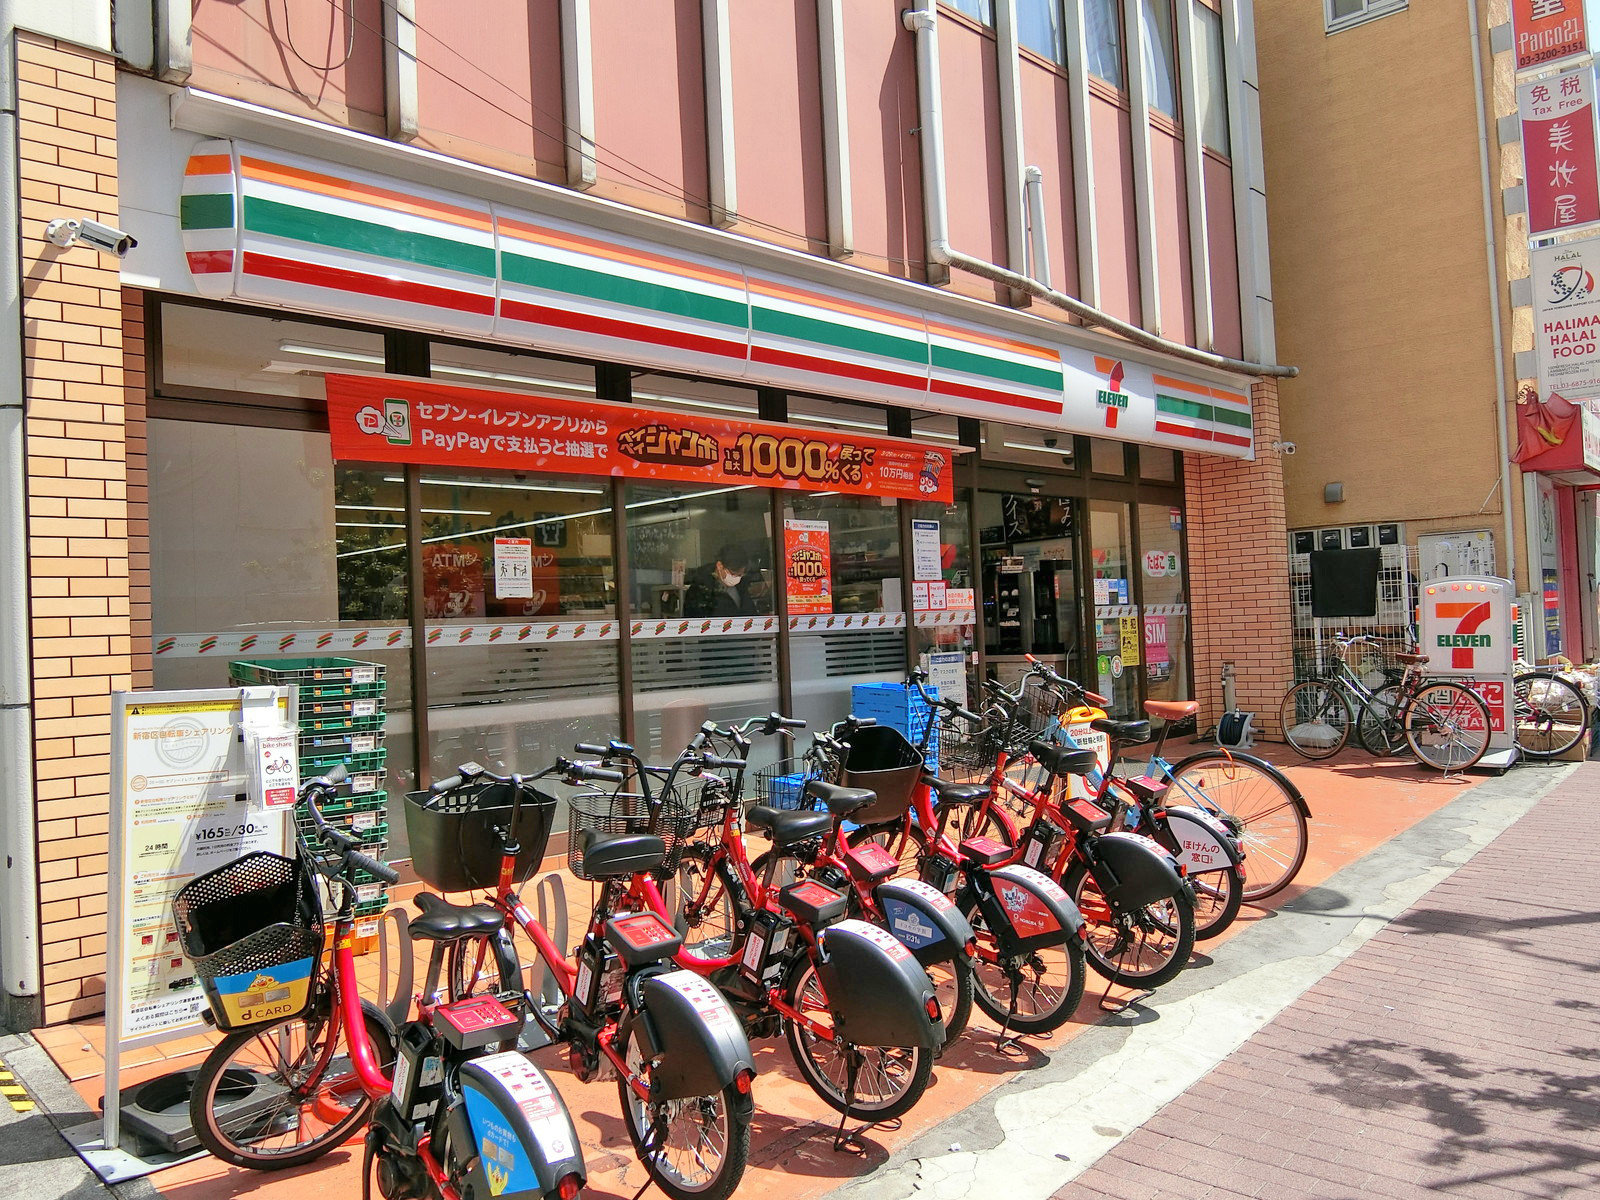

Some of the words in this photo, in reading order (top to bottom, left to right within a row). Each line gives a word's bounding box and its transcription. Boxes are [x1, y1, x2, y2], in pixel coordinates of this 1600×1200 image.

[1520, 41, 1584, 66] 03-3200-3151
[1530, 75, 1582, 104] 免税
[1533, 105, 1552, 116] Tax
[1559, 97, 1583, 110] Free
[1554, 251, 1582, 261] HALAL
[1543, 314, 1600, 334] HALIMA
[1550, 329, 1597, 346] HALAL
[1553, 343, 1596, 359] FOOD
[1097, 389, 1129, 409] ELEVEN
[422, 429, 609, 459] PayPayで支払うと抽選で
[645, 426, 718, 460] ジャンボ
[737, 434, 840, 480] 1000%
[840, 445, 875, 462] 戻って
[725, 460, 741, 471] 最大
[841, 464, 862, 481] くる
[880, 466, 914, 480] 10万円相当
[432, 553, 466, 568] ATM
[1147, 555, 1165, 570] たばこ
[1168, 555, 1176, 570] 酒
[1145, 623, 1167, 644] SIM
[1436, 601, 1490, 668] 7
[1437, 634, 1491, 647] ELEVEN
[195, 827, 225, 841] ¥165
[155, 842, 169, 850] 時間
[1183, 840, 1220, 854] ほけんの
[1191, 852, 1210, 864] 窓口
[241, 1009, 253, 1021] d
[255, 1004, 292, 1018] CARD
